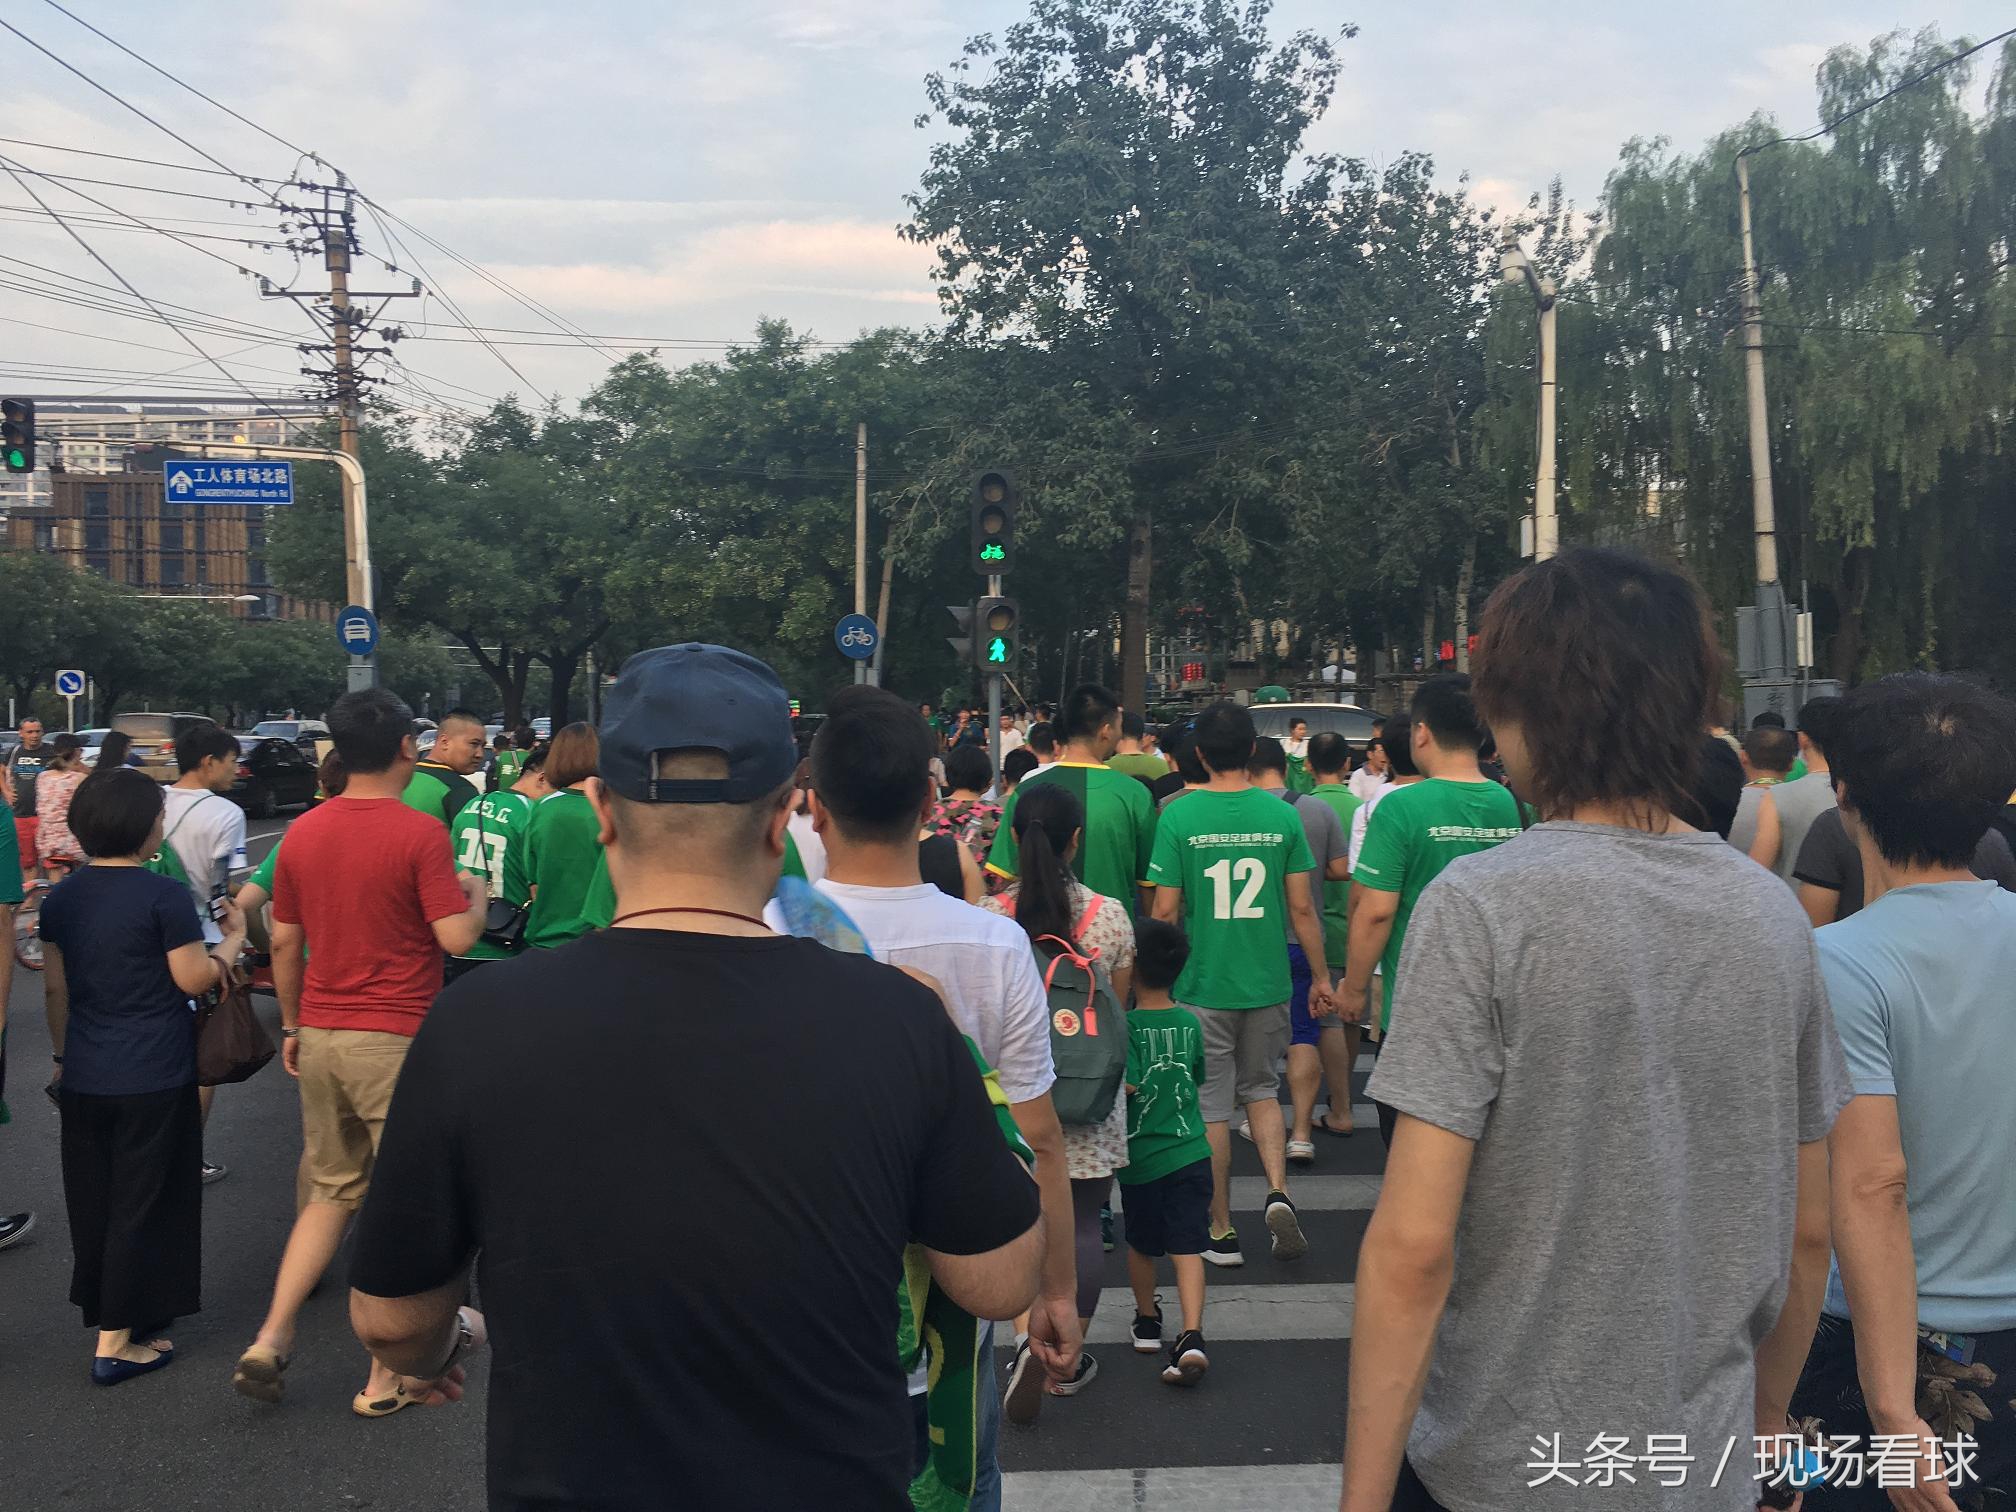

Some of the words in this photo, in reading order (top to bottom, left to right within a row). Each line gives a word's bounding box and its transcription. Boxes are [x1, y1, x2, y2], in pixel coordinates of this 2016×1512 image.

[193, 468, 288, 484] 工人体育场北路
[1203, 857, 1267, 920] 12
